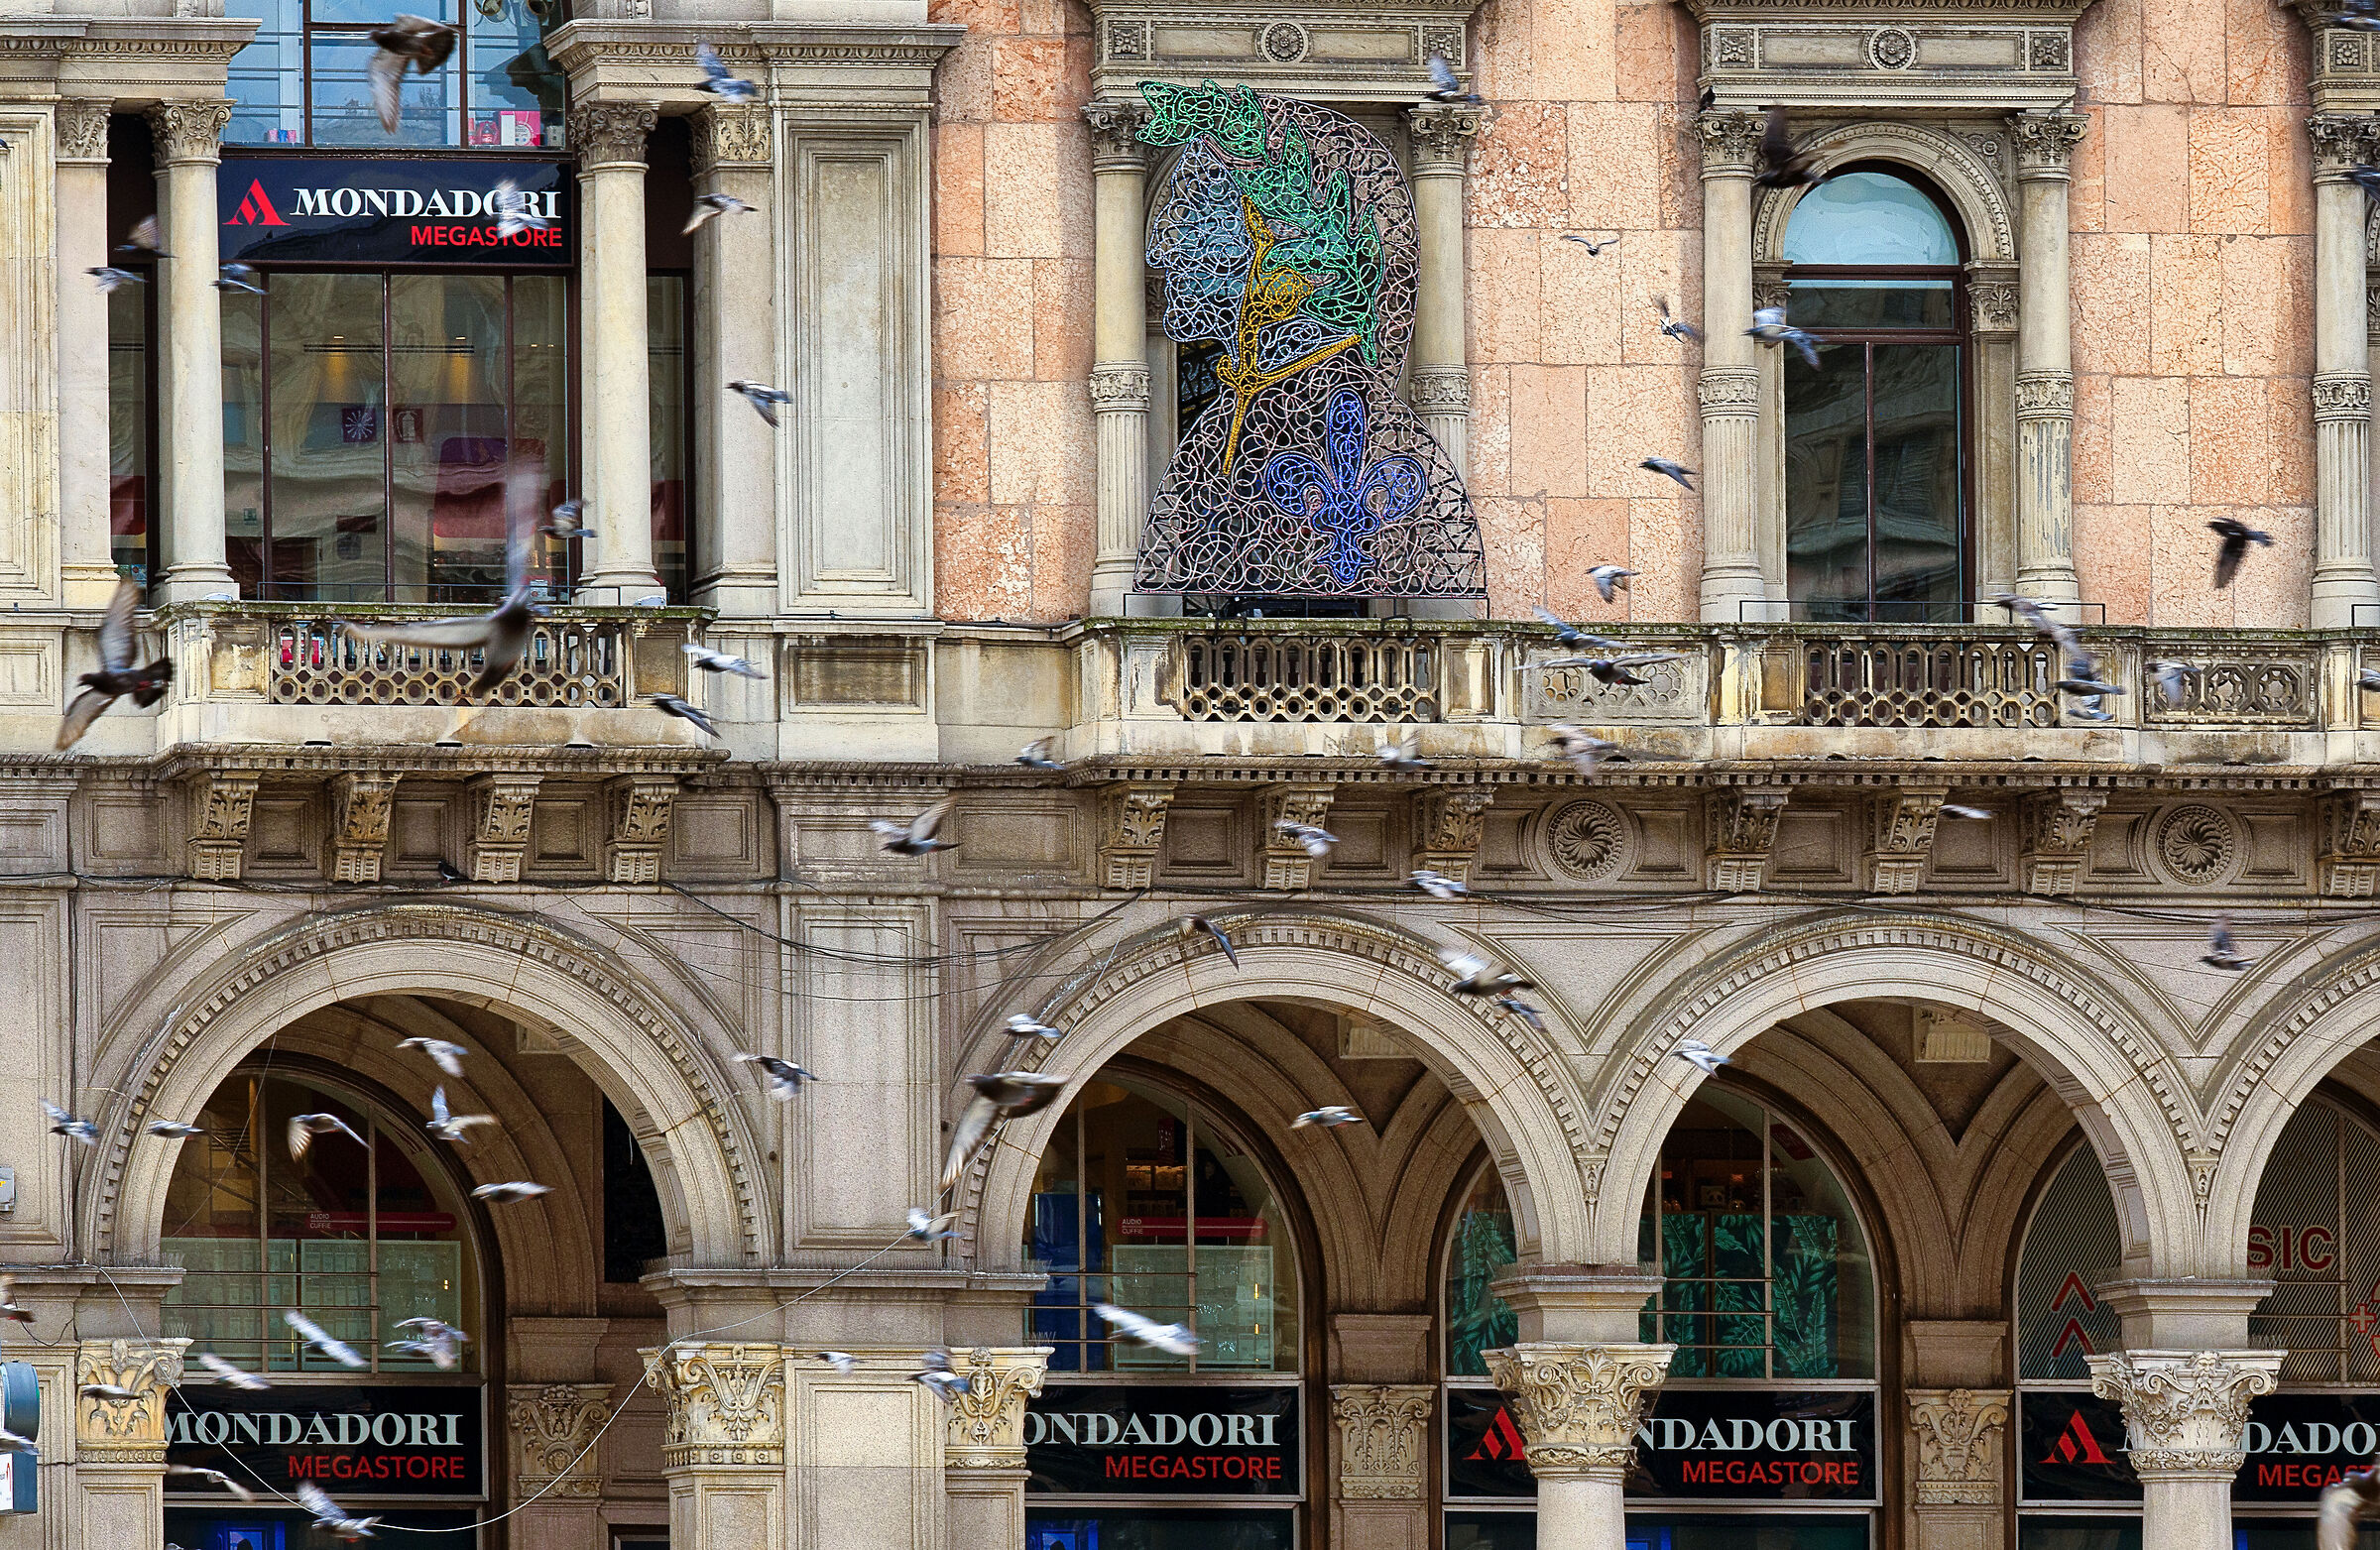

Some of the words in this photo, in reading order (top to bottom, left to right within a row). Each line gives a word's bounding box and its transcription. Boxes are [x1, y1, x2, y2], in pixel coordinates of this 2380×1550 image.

[290, 187, 561, 219] MONDADORI
[2247, 1224, 2334, 1270] SIC
[165, 1411, 464, 1446] MONDADORI
[1024, 1412, 1280, 1447] ONDADORI
[1636, 1417, 1857, 1452] NDADORI
[2241, 1420, 2380, 1456] DADO
[288, 1455, 465, 1479] MEGASTORE
[1105, 1455, 1281, 1479] MEGASTORE
[1682, 1461, 1858, 1485] MEGASTORE
